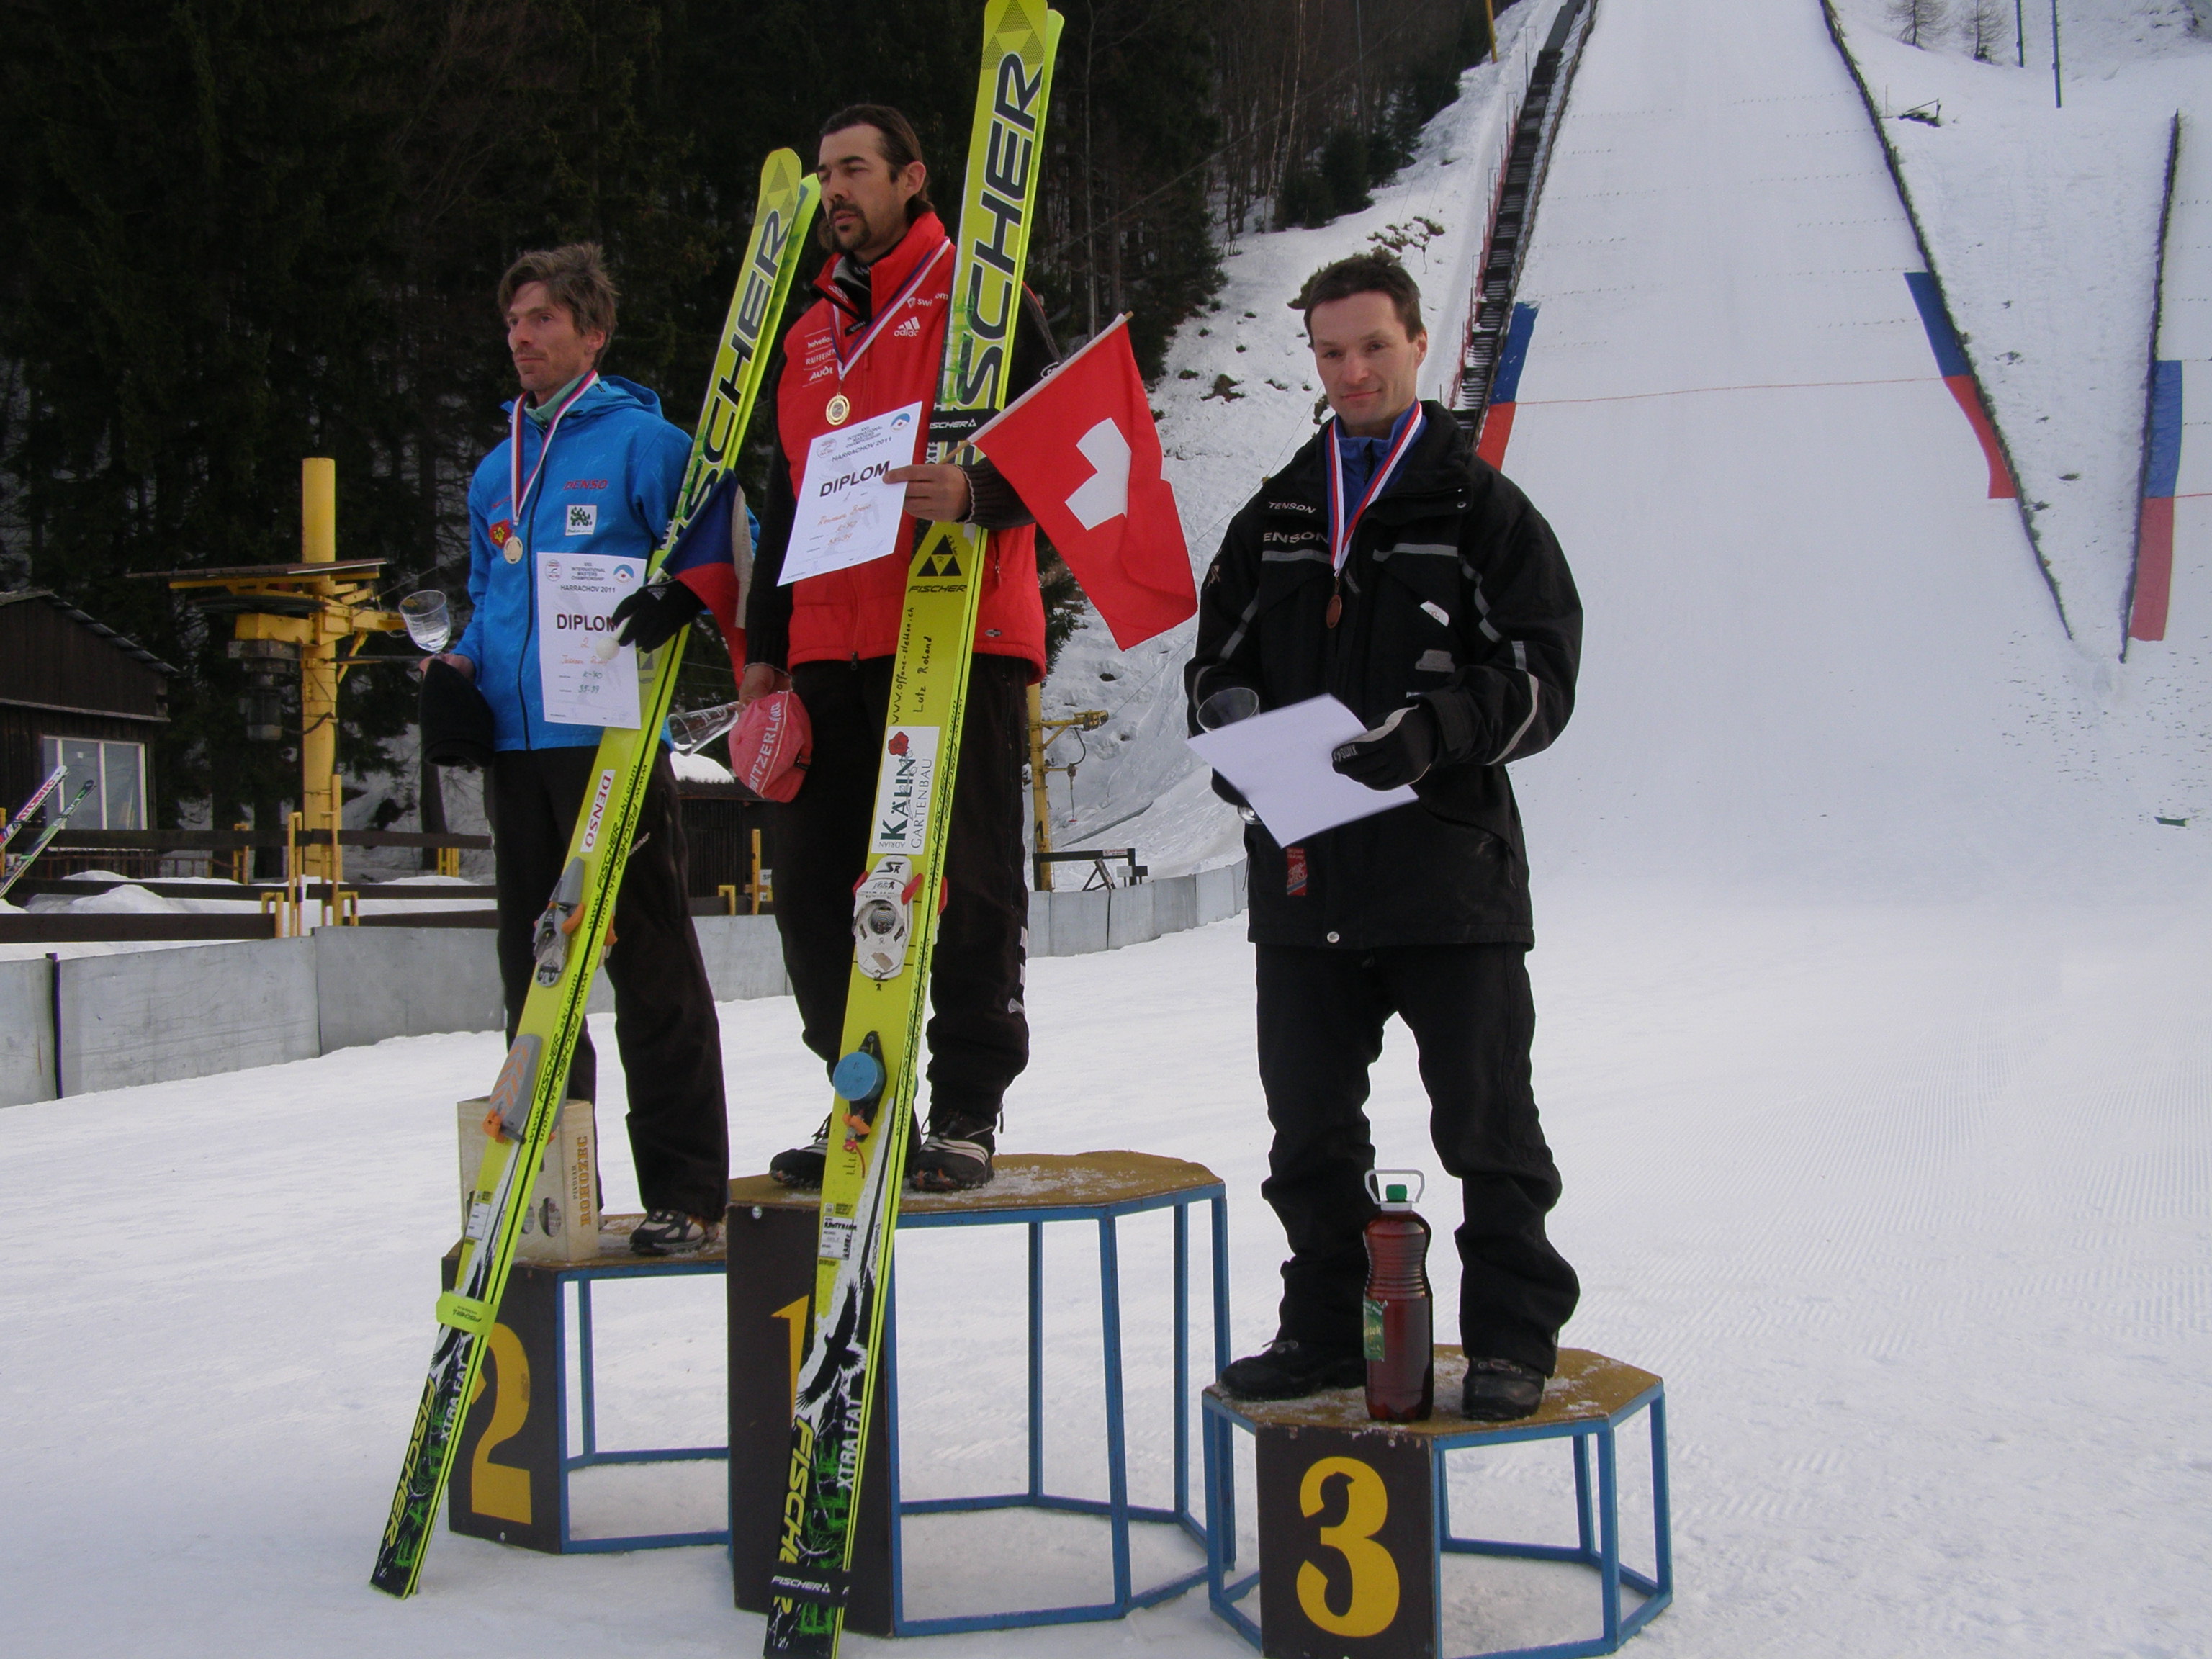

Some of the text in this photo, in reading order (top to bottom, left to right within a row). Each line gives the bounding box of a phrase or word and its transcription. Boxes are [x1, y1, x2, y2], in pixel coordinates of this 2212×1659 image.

[954, 50, 1043, 408] SCHER
[677, 210, 792, 529] SCHER
[876, 436, 892, 447] 2011
[563, 480, 608, 490] DENSO
[819, 460, 890, 498] DIPLOM
[1268, 501, 1316, 514] TENSON
[1263, 531, 1329, 544] ENSON
[908, 584, 968, 593] FISCHER
[17, 778, 56, 820] ATOMIC
[585, 775, 611, 848] DENSO
[911, 758, 932, 848] GARTENBAU
[577, 1136, 592, 1226] ROHOZEC
[472, 1321, 532, 1525] 2
[385, 1373, 436, 1547] FISCHER
[837, 1439, 857, 1491] XTRA
[1296, 1455, 1401, 1638] 3
[771, 1575, 821, 1591] FISCHER
